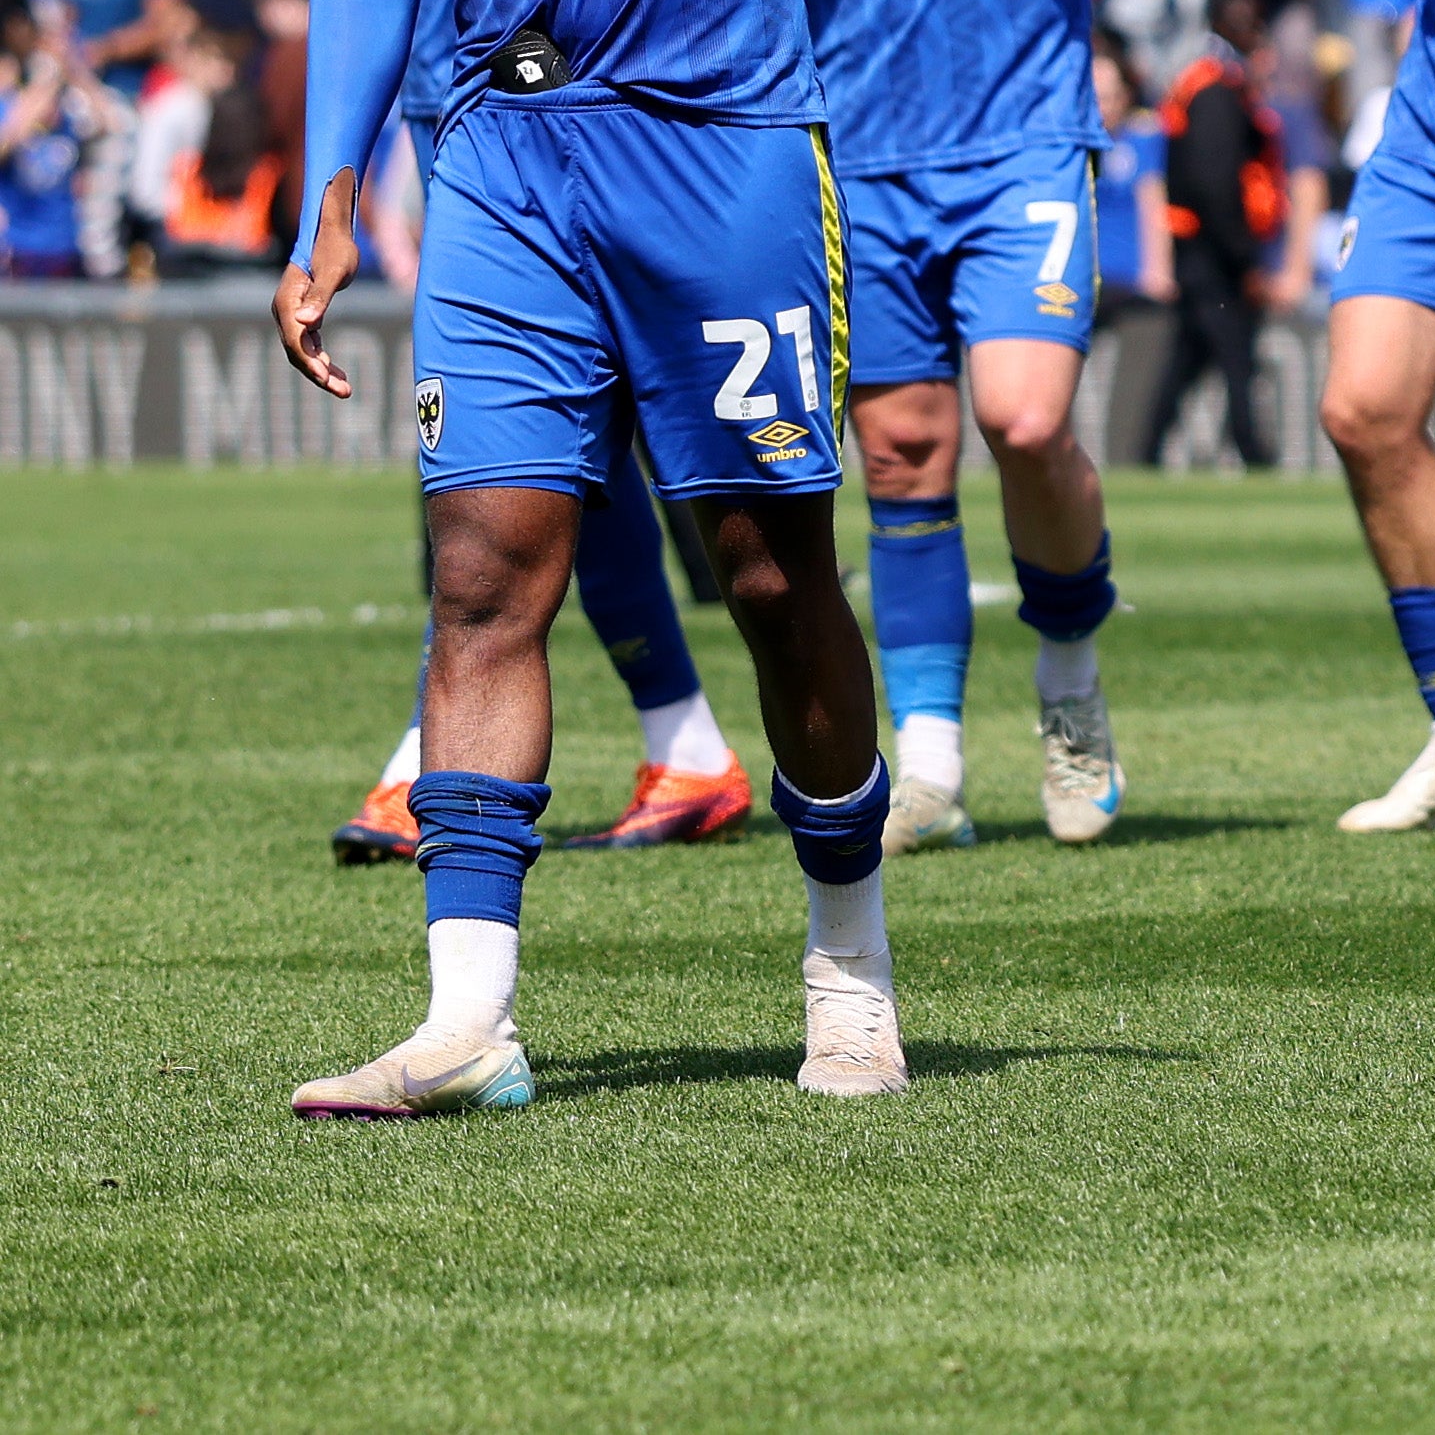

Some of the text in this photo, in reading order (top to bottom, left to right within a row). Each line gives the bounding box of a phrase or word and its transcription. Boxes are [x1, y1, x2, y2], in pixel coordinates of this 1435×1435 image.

[1025, 200, 1078, 283] 7
[701, 305, 820, 421] 21
[756, 446, 808, 464] umbro
